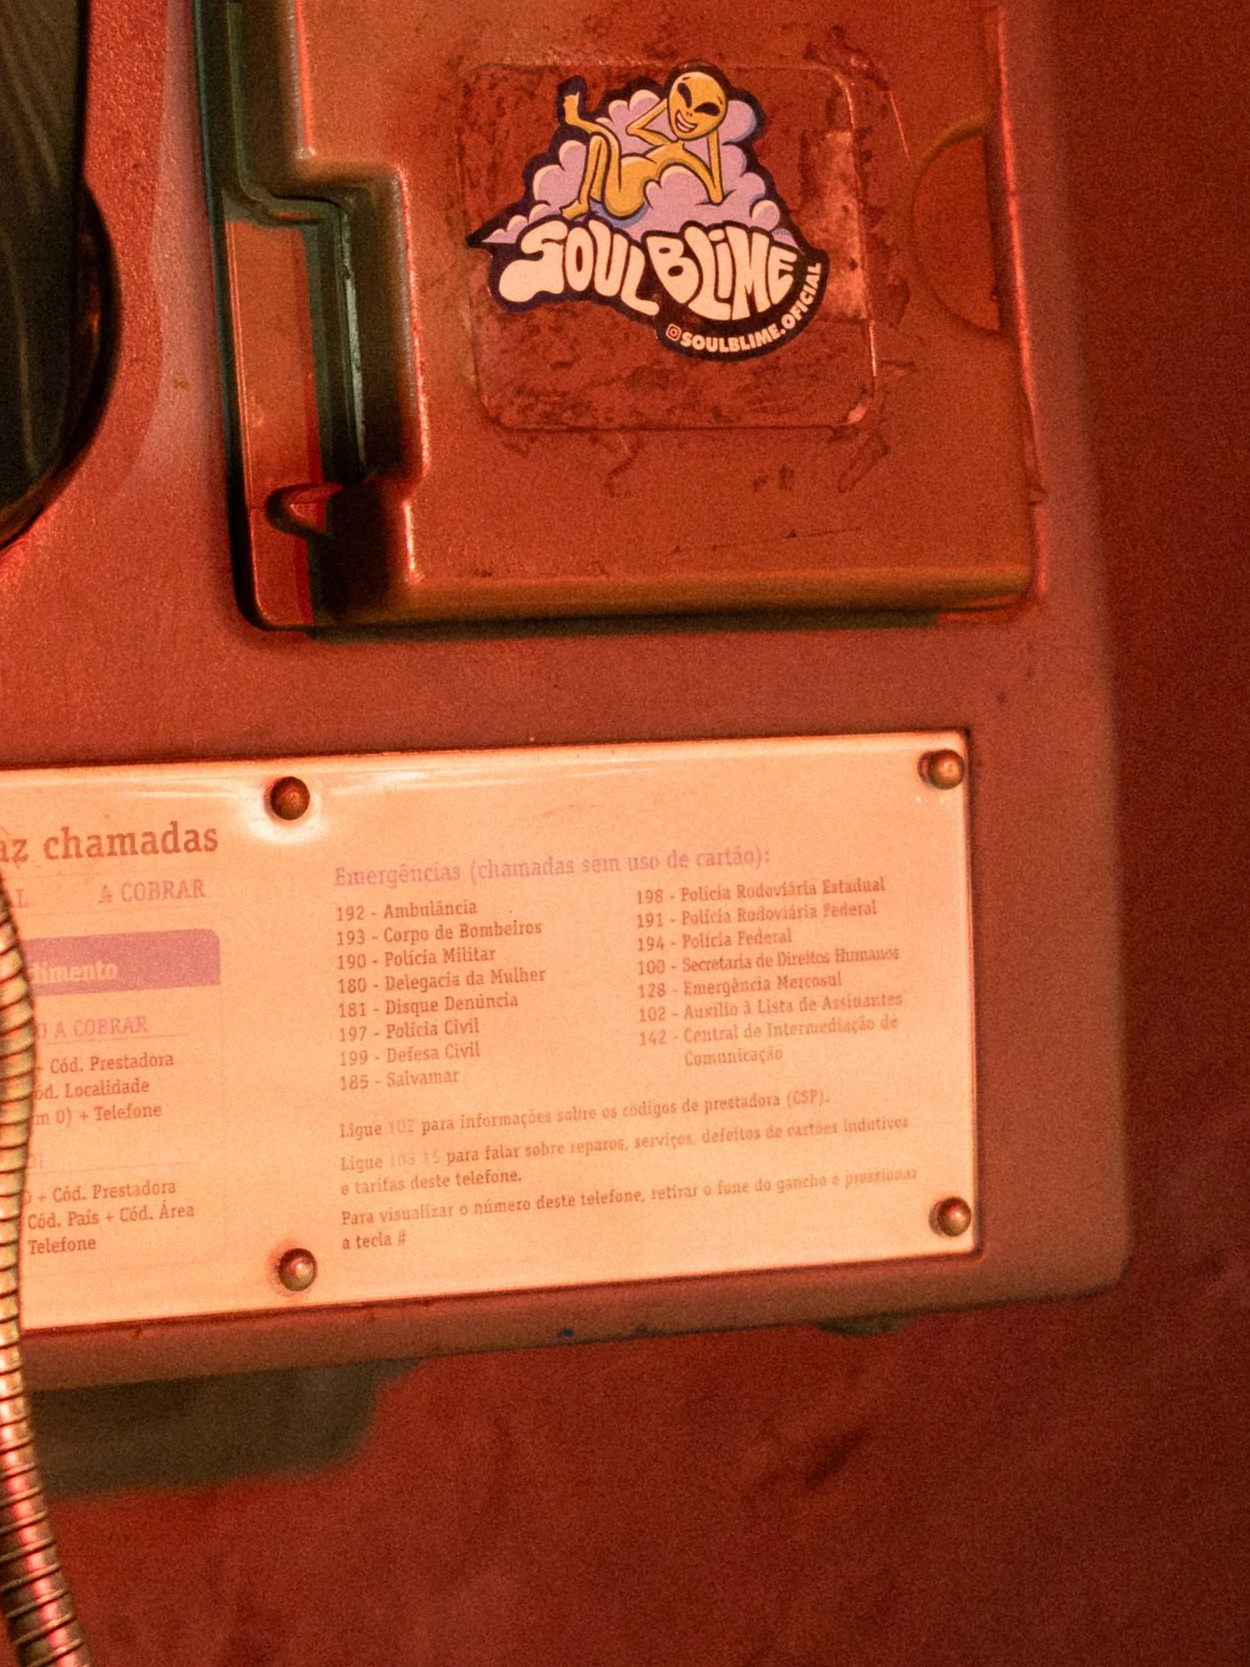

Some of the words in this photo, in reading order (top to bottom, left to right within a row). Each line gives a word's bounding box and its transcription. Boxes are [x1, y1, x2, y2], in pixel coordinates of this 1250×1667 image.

[43, 820, 219, 861] chamadas
[334, 862, 461, 890] Emergências
[471, 856, 575, 884] (chamadas
[583, 857, 620, 873] sem
[627, 854, 660, 871] uso
[666, 850, 690, 869] de
[696, 847, 771, 870] cartão):
[121, 878, 206, 903] COBRAR
[637, 889, 664, 905] 198
[680, 885, 732, 902] Polícia
[737, 880, 817, 899] Rodoviária
[822, 877, 886, 894] Estadual
[336, 905, 365, 922] 192
[383, 899, 478, 920] Ambulância
[637, 913, 664, 929] 191
[681, 908, 732, 926] Polícia
[737, 903, 817, 923] Rodoviária
[823, 899, 877, 918] Federal
[337, 930, 365, 946] 193
[384, 926, 429, 945] Corpo
[435, 924, 454, 941] de
[459, 919, 543, 939] Bombeiros
[637, 936, 665, 952] 194
[682, 932, 732, 949] Polícia
[737, 928, 792, 946] Federal
[29, 960, 118, 982] dimento
[337, 954, 367, 970] 190
[385, 949, 437, 968] Polícia
[442, 947, 496, 964] Militar
[638, 960, 666, 975] 100
[682, 952, 751, 973] Secretaria
[756, 952, 773, 968] de
[777, 949, 831, 968] Direitos
[835, 946, 900, 964] Humanos
[338, 978, 367, 994] 180
[385, 973, 461, 993] Delegacia
[466, 970, 484, 986] da
[490, 966, 547, 984] Mulher
[638, 983, 666, 999] 128
[683, 978, 771, 998] Emergência
[777, 971, 842, 990] Mercosul
[338, 1002, 367, 1018] 181
[386, 997, 439, 1017] Disque
[444, 991, 519, 1012] Denúncia
[638, 1006, 666, 1023] 102
[757, 997, 794, 1015] Lista
[799, 995, 817, 1012] de
[822, 992, 903, 1011] Assinantes
[54, 1022, 69, 1038] A
[74, 1016, 149, 1038] COBRAR
[339, 1027, 367, 1042] 197
[386, 1021, 439, 1040] Polícia
[444, 1017, 480, 1034] Civil
[684, 1024, 739, 1044] Central
[743, 1022, 762, 1039] de
[767, 1016, 876, 1039] Intermediação
[881, 1014, 899, 1031] de
[50, 1057, 84, 1074] Cód.
[90, 1052, 175, 1072] Prestadora
[339, 1050, 368, 1067] 199
[387, 1046, 440, 1064] Defesa
[445, 1041, 481, 1059] Civil
[684, 1048, 784, 1068] Comunicação
[35, 1084, 58, 1100] ód.
[65, 1078, 150, 1098] Localidade
[340, 1074, 369, 1091] 185
[387, 1068, 460, 1088] Salvamar
[94, 1102, 162, 1122] Telefone
[340, 1122, 382, 1141] Ligue
[422, 1117, 455, 1136] para
[460, 1111, 551, 1130] informações
[557, 1106, 597, 1123] sobre
[602, 1106, 618, 1119] os
[622, 1098, 677, 1118] códigos
[682, 1099, 699, 1113] de
[703, 1092, 781, 1114] prestadora
[341, 1155, 383, 1174] Ligue
[446, 1149, 480, 1168] para
[485, 1144, 520, 1162] falar
[525, 1141, 565, 1158] sobre
[570, 1137, 629, 1157] reparos,
[702, 1126, 761, 1144] defeitos
[766, 1125, 783, 1140] de
[787, 1121, 838, 1138] cartões
[843, 1115, 910, 1133] indutivos
[52, 1186, 86, 1203] Cód.
[93, 1180, 176, 1200] Prestadora
[341, 1184, 350, 1196] e
[355, 1176, 405, 1195] tarifas
[410, 1173, 451, 1190] deste
[455, 1169, 522, 1186] telefone.
[342, 1209, 374, 1226] Para
[380, 1203, 454, 1222] visualizar
[459, 1205, 469, 1216] o
[473, 1198, 531, 1215] número
[536, 1193, 576, 1210] deste
[580, 1188, 647, 1207] telefone,
[650, 1184, 698, 1201] retirar
[703, 1185, 712, 1196] o
[717, 1179, 750, 1195] fone
[754, 1176, 772, 1191] do
[777, 1172, 827, 1194] gancho
[831, 1174, 839, 1187] e
[845, 1168, 918, 1189] pressionar
[28, 1214, 62, 1230] Cód.
[68, 1209, 99, 1227] País
[120, 1205, 154, 1222] Cód.
[159, 1199, 195, 1220] Área
[28, 1237, 97, 1255] Telefone
[342, 1238, 351, 1250] a
[355, 1232, 392, 1249] tecla
